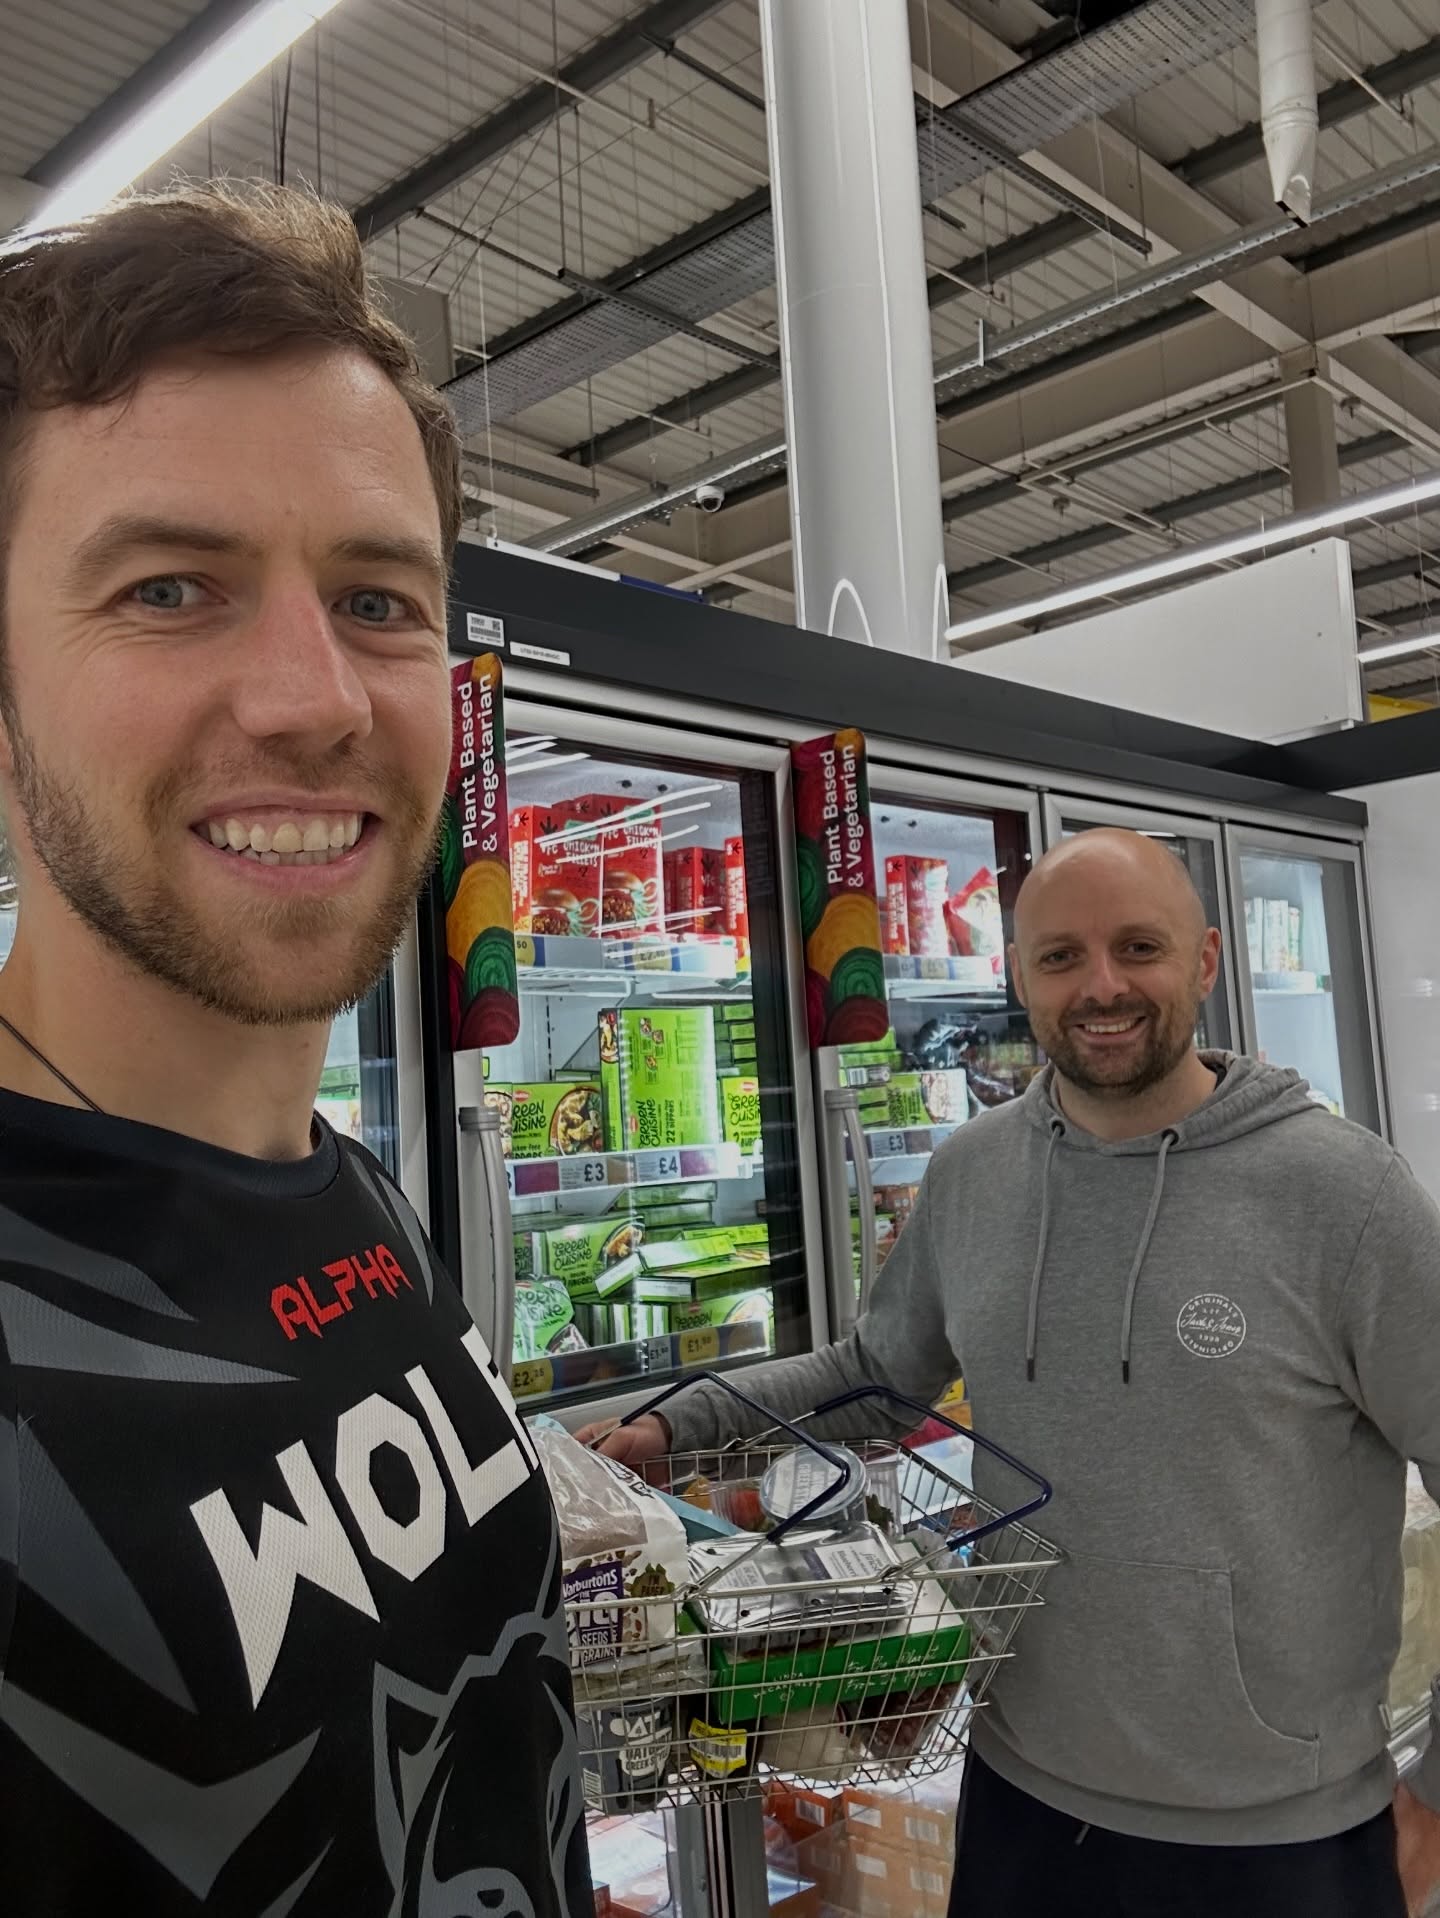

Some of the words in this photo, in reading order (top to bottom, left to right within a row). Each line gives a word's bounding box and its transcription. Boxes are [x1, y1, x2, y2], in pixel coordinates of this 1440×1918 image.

[457, 681, 475, 768] Based
[477, 674, 499, 829] Vegetarian
[819, 749, 839, 820] Based
[462, 774, 478, 849] Plant
[840, 745, 865, 870] Vegetarian
[482, 832, 498, 852] &
[825, 824, 843, 884] Plant
[848, 872, 864, 887] &
[512, 1100, 544, 1120] REEN
[666, 1130, 675, 1143] 22
[889, 1135, 904, 1151] £3
[584, 1163, 605, 1182] £3
[659, 1157, 678, 1174] £4
[270, 1244, 413, 1340] ALPHA
[581, 1631, 609, 1647] SEEDS
[583, 1647, 616, 1663] GRAINS
[773, 1672, 803, 1682] LINDA
